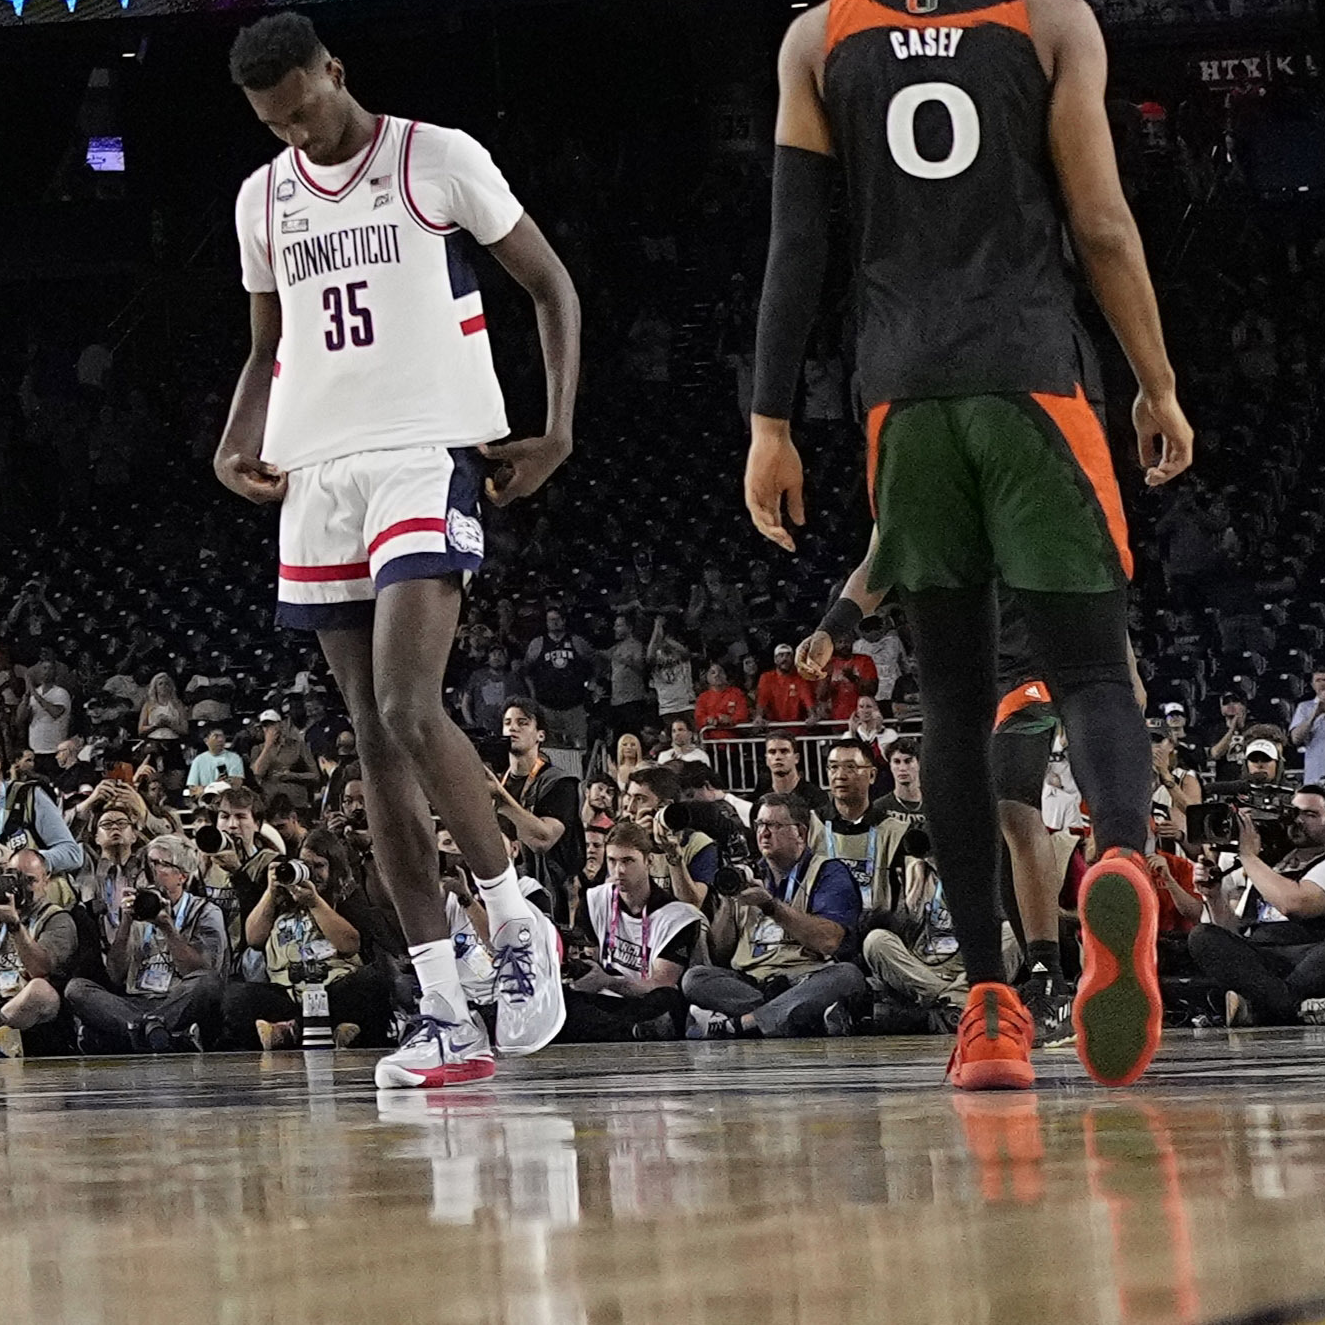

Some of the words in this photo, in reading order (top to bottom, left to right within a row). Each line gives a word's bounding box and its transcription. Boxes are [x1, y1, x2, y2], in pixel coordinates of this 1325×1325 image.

[889, 26, 964, 60] CASEY
[886, 82, 980, 180] 0
[282, 225, 401, 287] CONNECTICUT
[322, 280, 374, 352] 35
